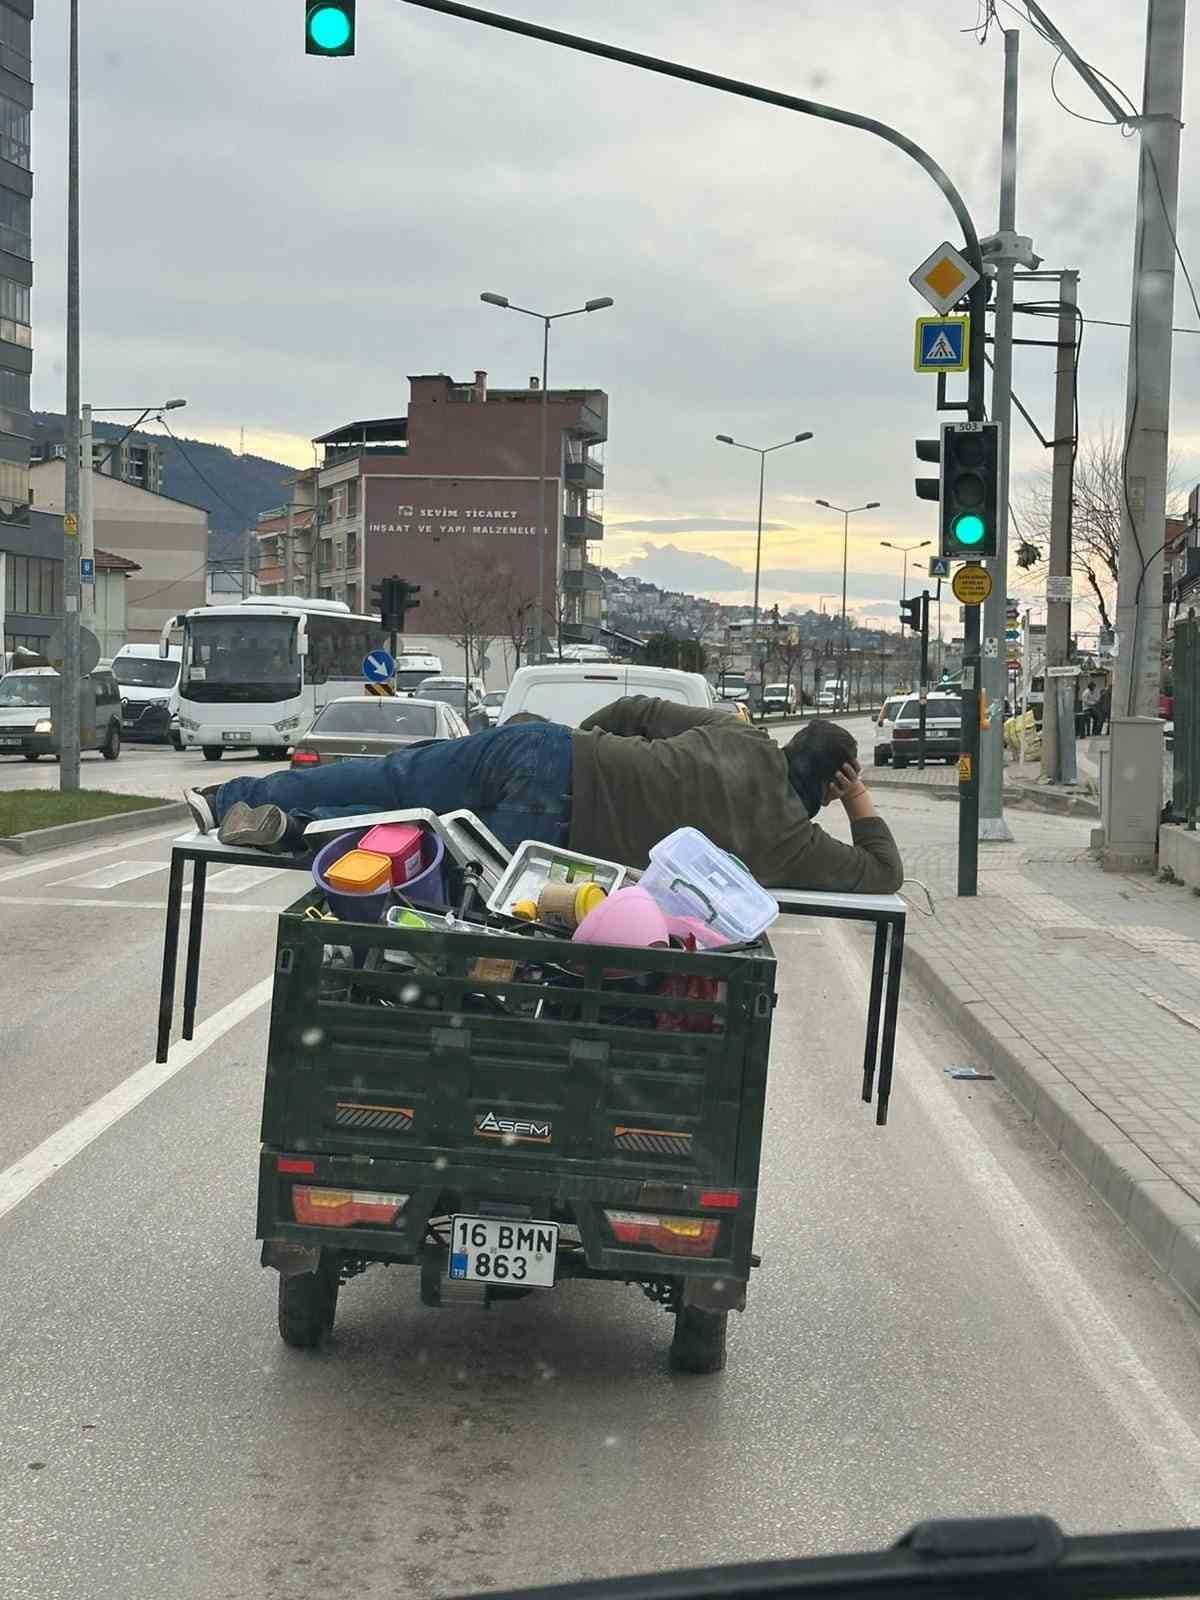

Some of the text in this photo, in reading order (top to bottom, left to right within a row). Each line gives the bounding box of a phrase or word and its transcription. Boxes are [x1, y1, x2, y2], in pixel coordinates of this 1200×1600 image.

[959, 422, 977, 431] 503
[418, 525, 432, 533] VE
[440, 526, 466, 534] YAPI
[459, 1222, 553, 1254] 16 BMN
[475, 1252, 527, 1280] 863
